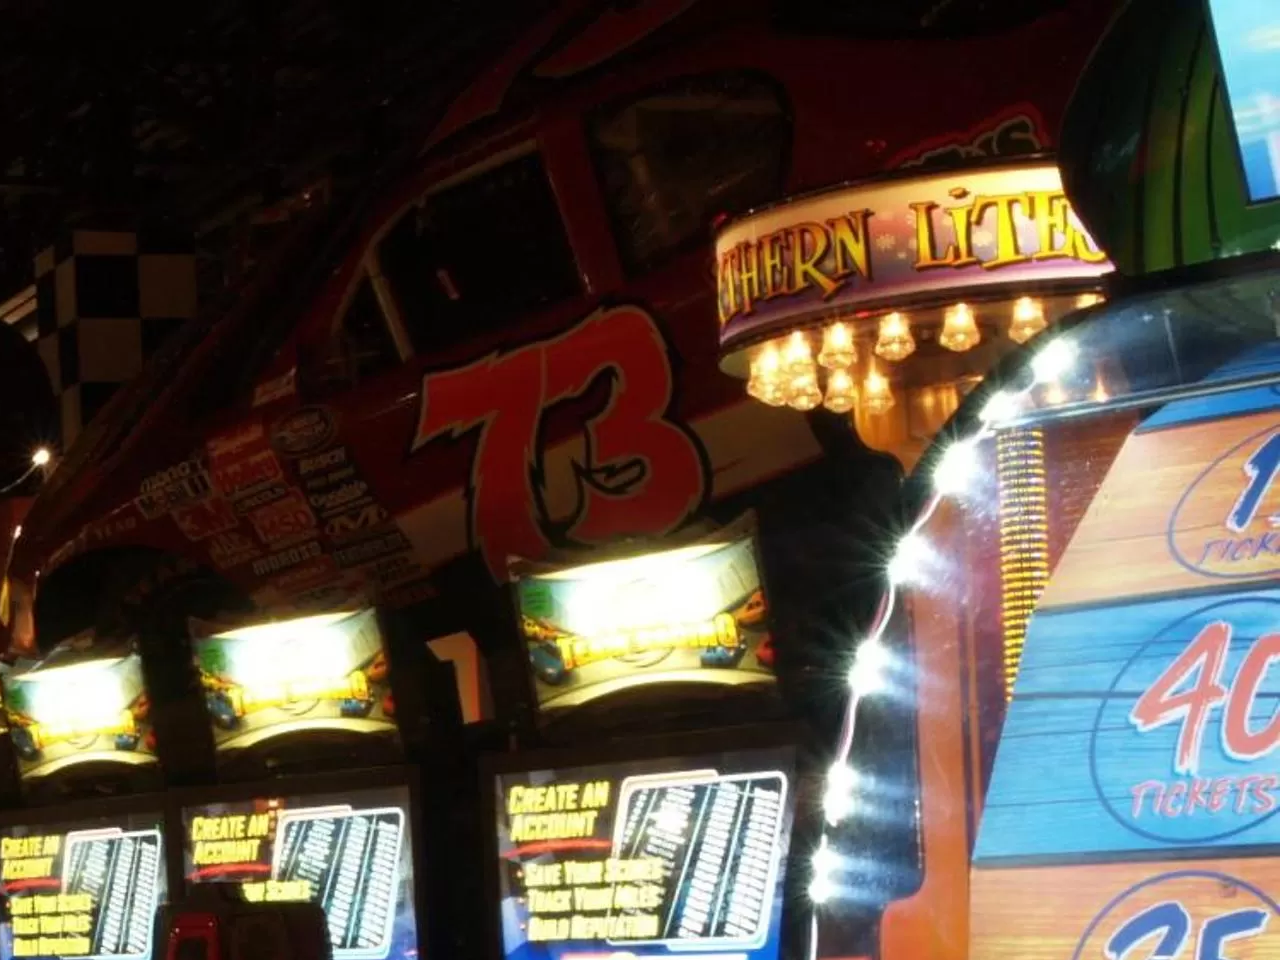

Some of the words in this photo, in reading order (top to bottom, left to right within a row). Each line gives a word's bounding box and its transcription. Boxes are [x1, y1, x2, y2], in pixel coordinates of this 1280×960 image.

[410, 304, 704, 586] 73
[1226, 430, 1280, 532] 1
[1199, 535, 1280, 565] TICK
[1128, 619, 1280, 775] 40
[509, 783, 580, 814] CREATE
[581, 780, 610, 808] AN
[1128, 774, 1276, 819] TICKETS
[192, 815, 247, 840] CREATE
